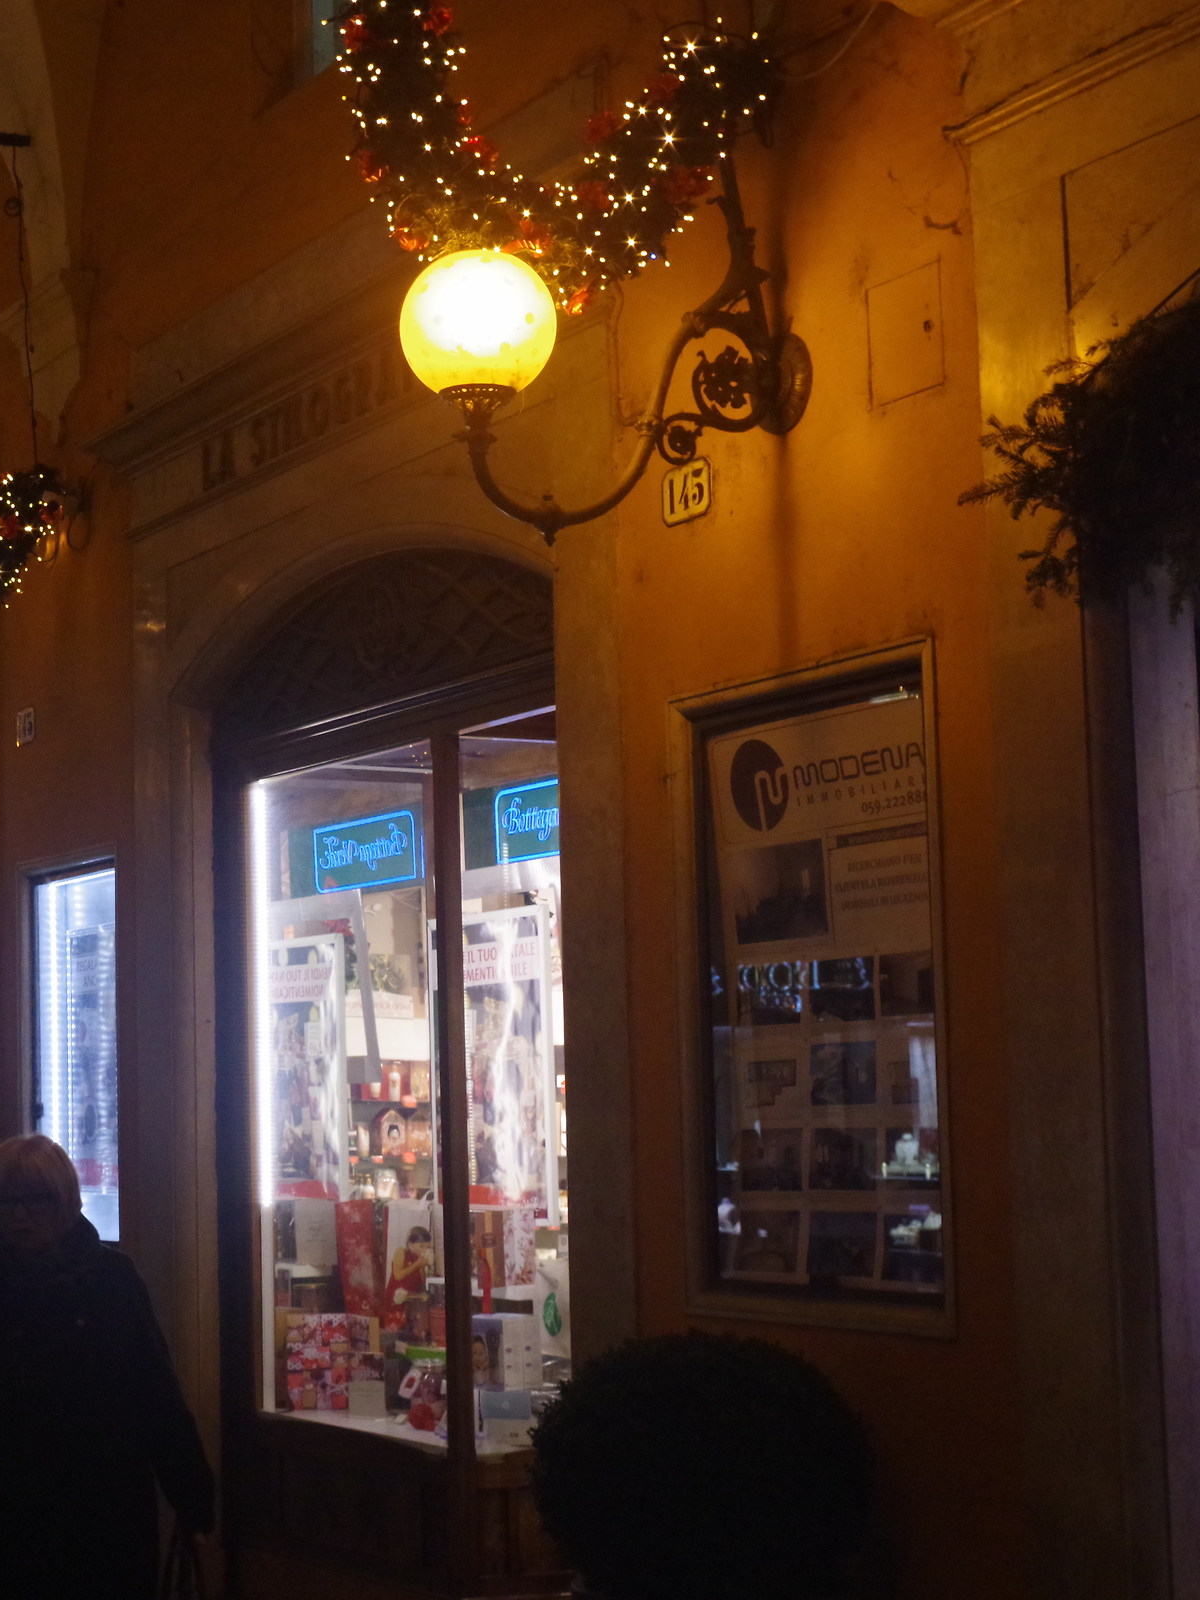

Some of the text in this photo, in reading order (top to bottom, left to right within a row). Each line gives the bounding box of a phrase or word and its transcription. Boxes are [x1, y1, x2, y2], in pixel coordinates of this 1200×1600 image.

[201, 431, 237, 491] LA
[668, 467, 705, 515] 145
[793, 742, 925, 789] MODENA
[502, 797, 559, 842] Bottega
[467, 951, 476, 964] IL
[477, 946, 498, 962] TUO
